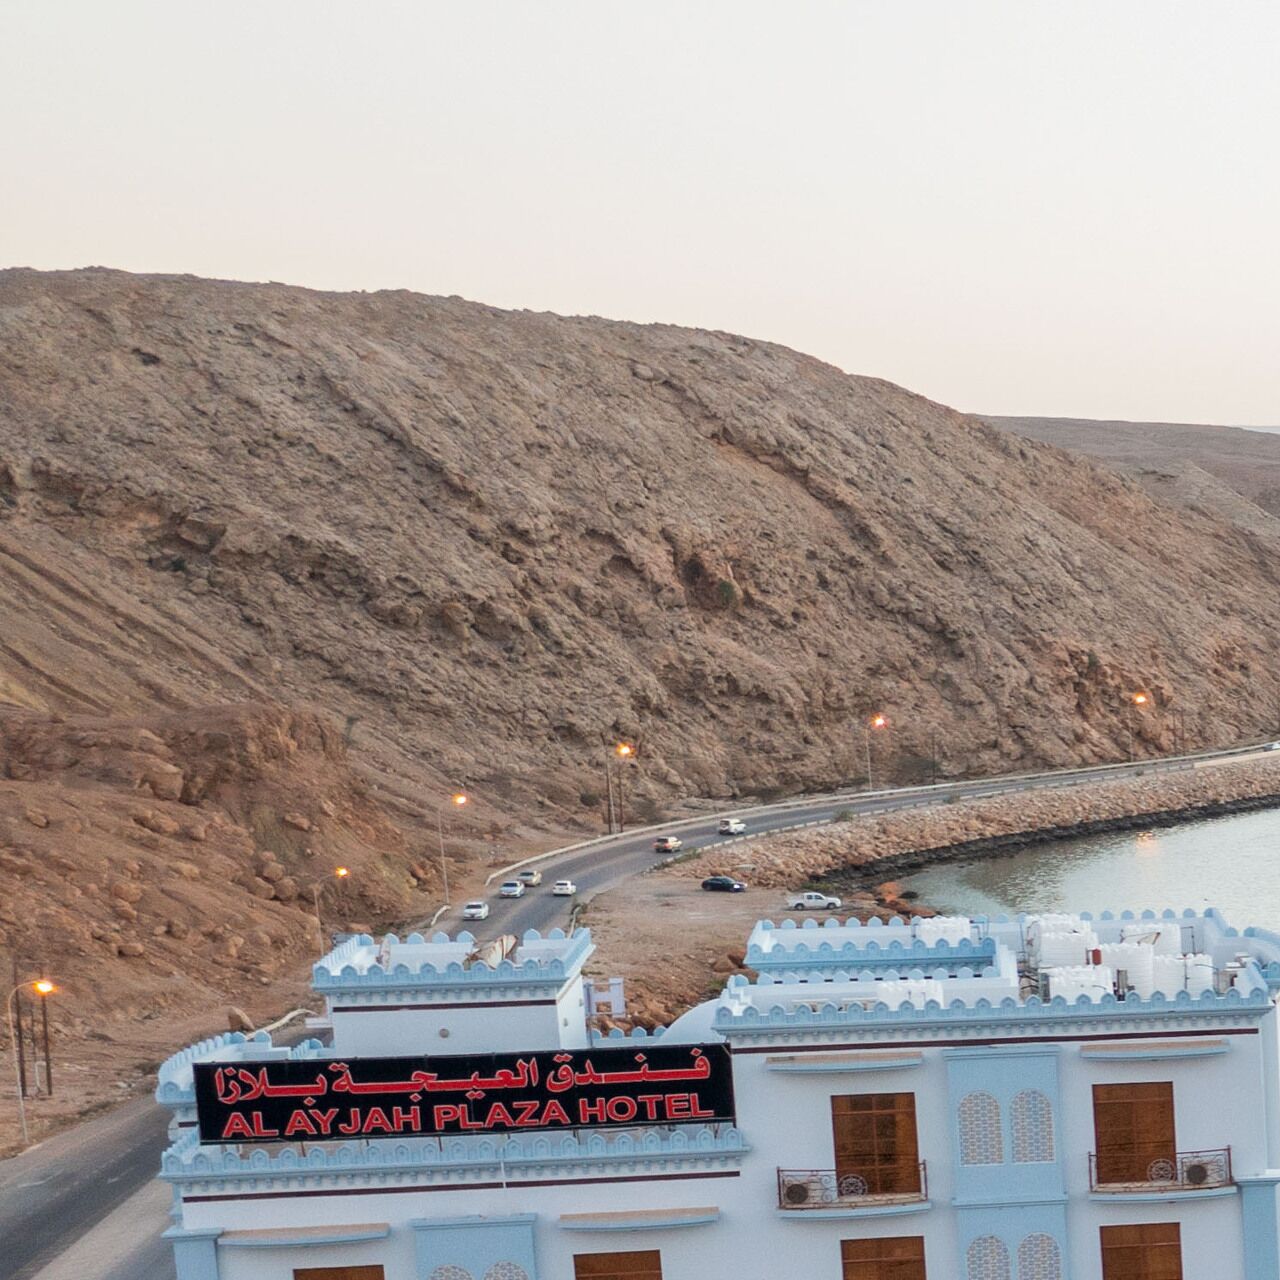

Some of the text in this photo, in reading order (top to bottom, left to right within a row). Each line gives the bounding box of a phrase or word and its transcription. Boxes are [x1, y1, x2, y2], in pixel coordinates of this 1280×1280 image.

[214, 1047, 711, 1106] فندق العيجة بلازا
[221, 1092, 715, 1138] AL AYJAH PLAZA HOTEL
